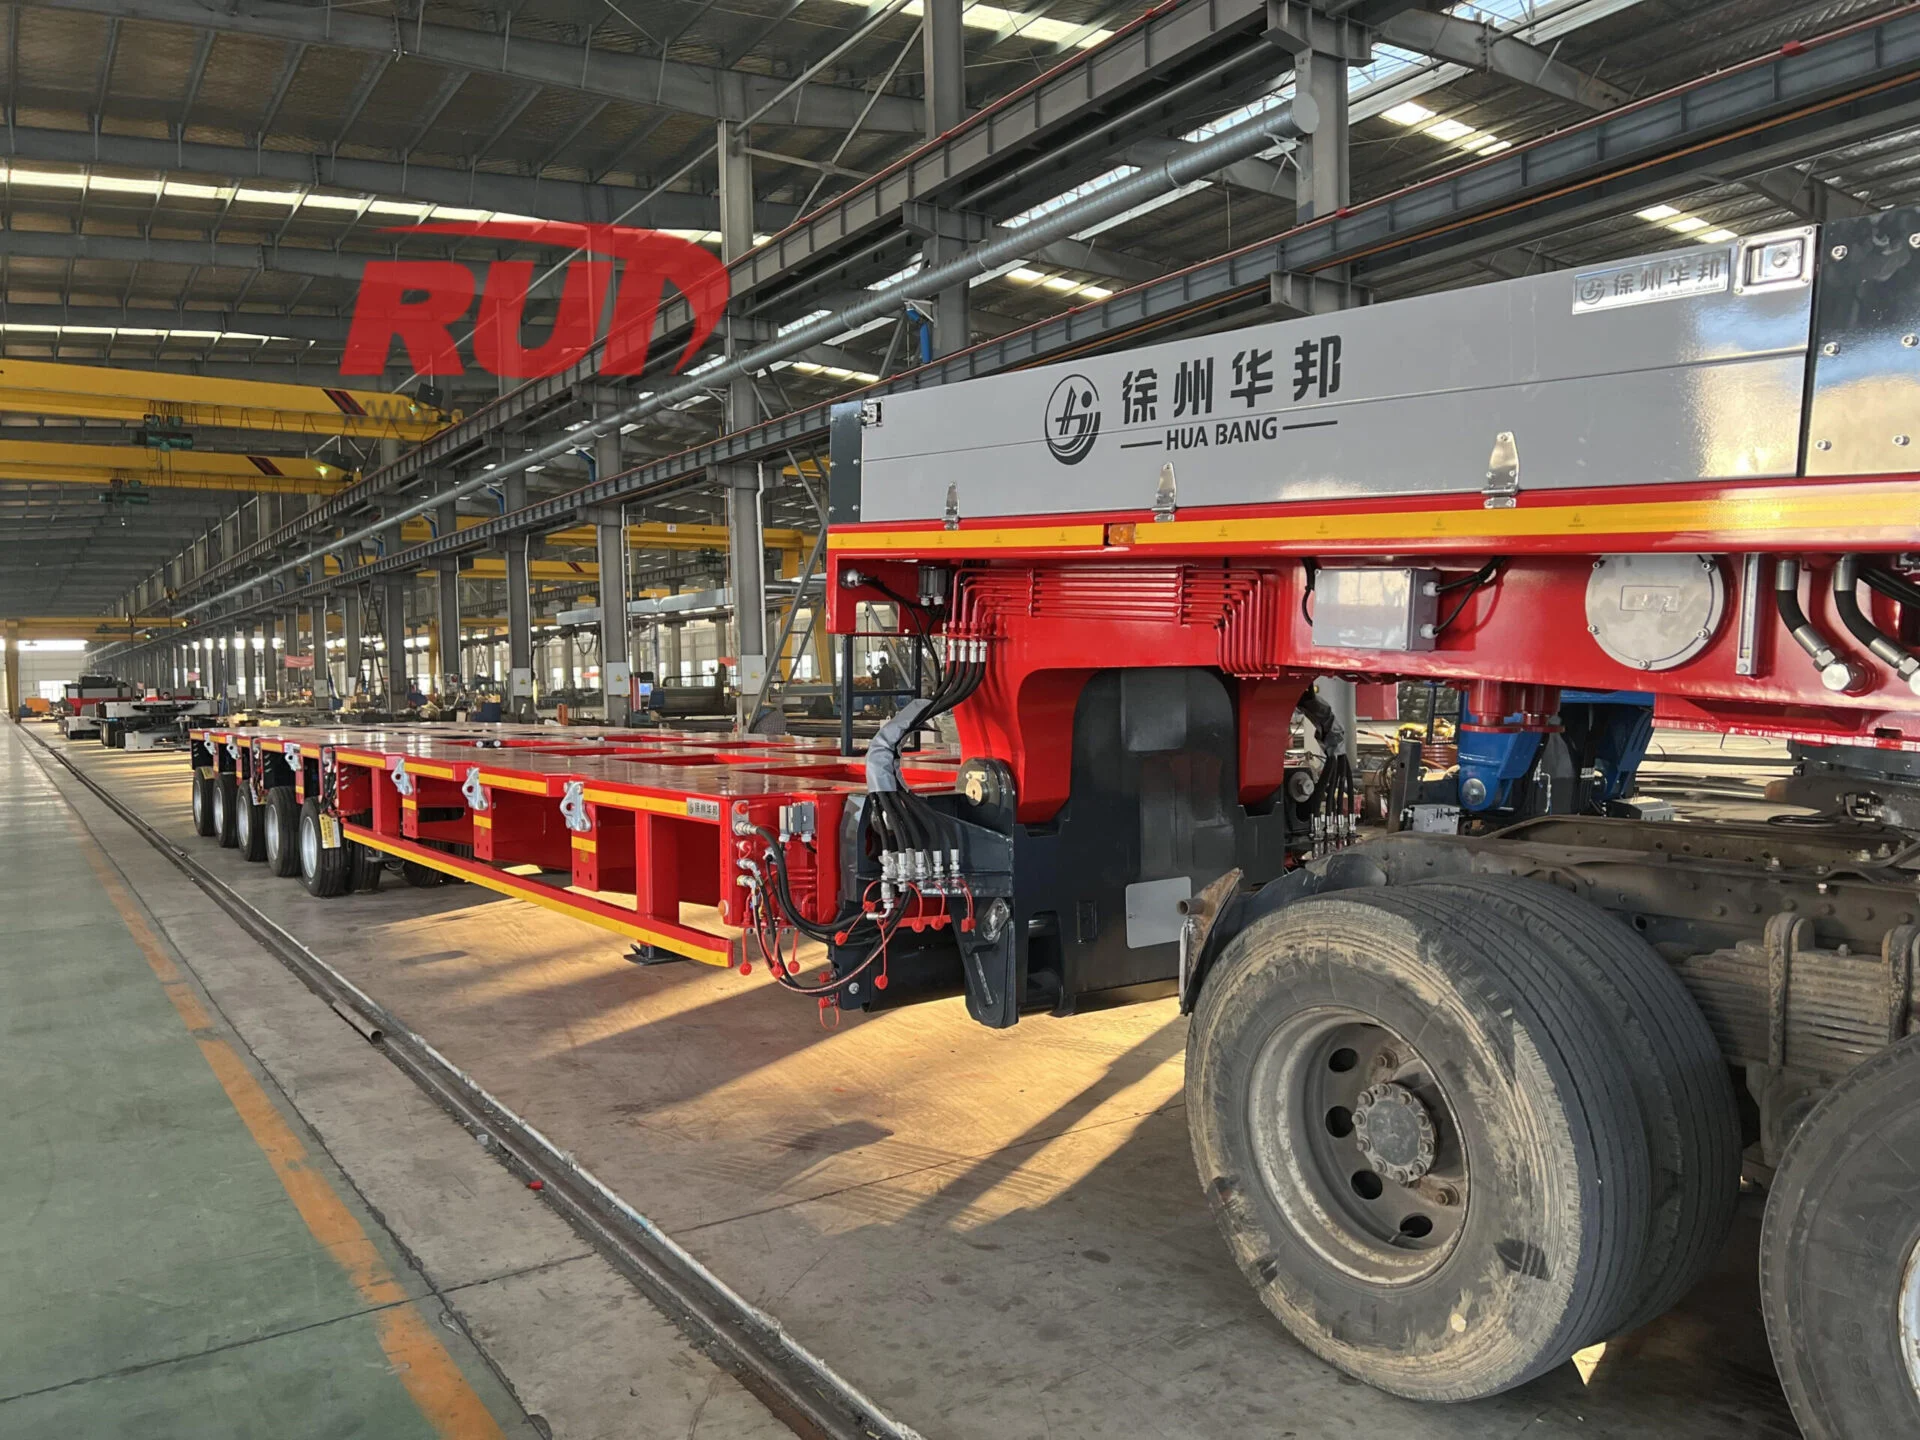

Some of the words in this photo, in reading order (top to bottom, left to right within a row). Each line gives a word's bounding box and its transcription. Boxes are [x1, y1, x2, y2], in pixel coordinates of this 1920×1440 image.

[1613, 258, 1720, 296] 徐州华邦
[1122, 335, 1342, 425] 徐州华邦
[1166, 426, 1208, 451] HUA
[1215, 417, 1278, 446] BANG
